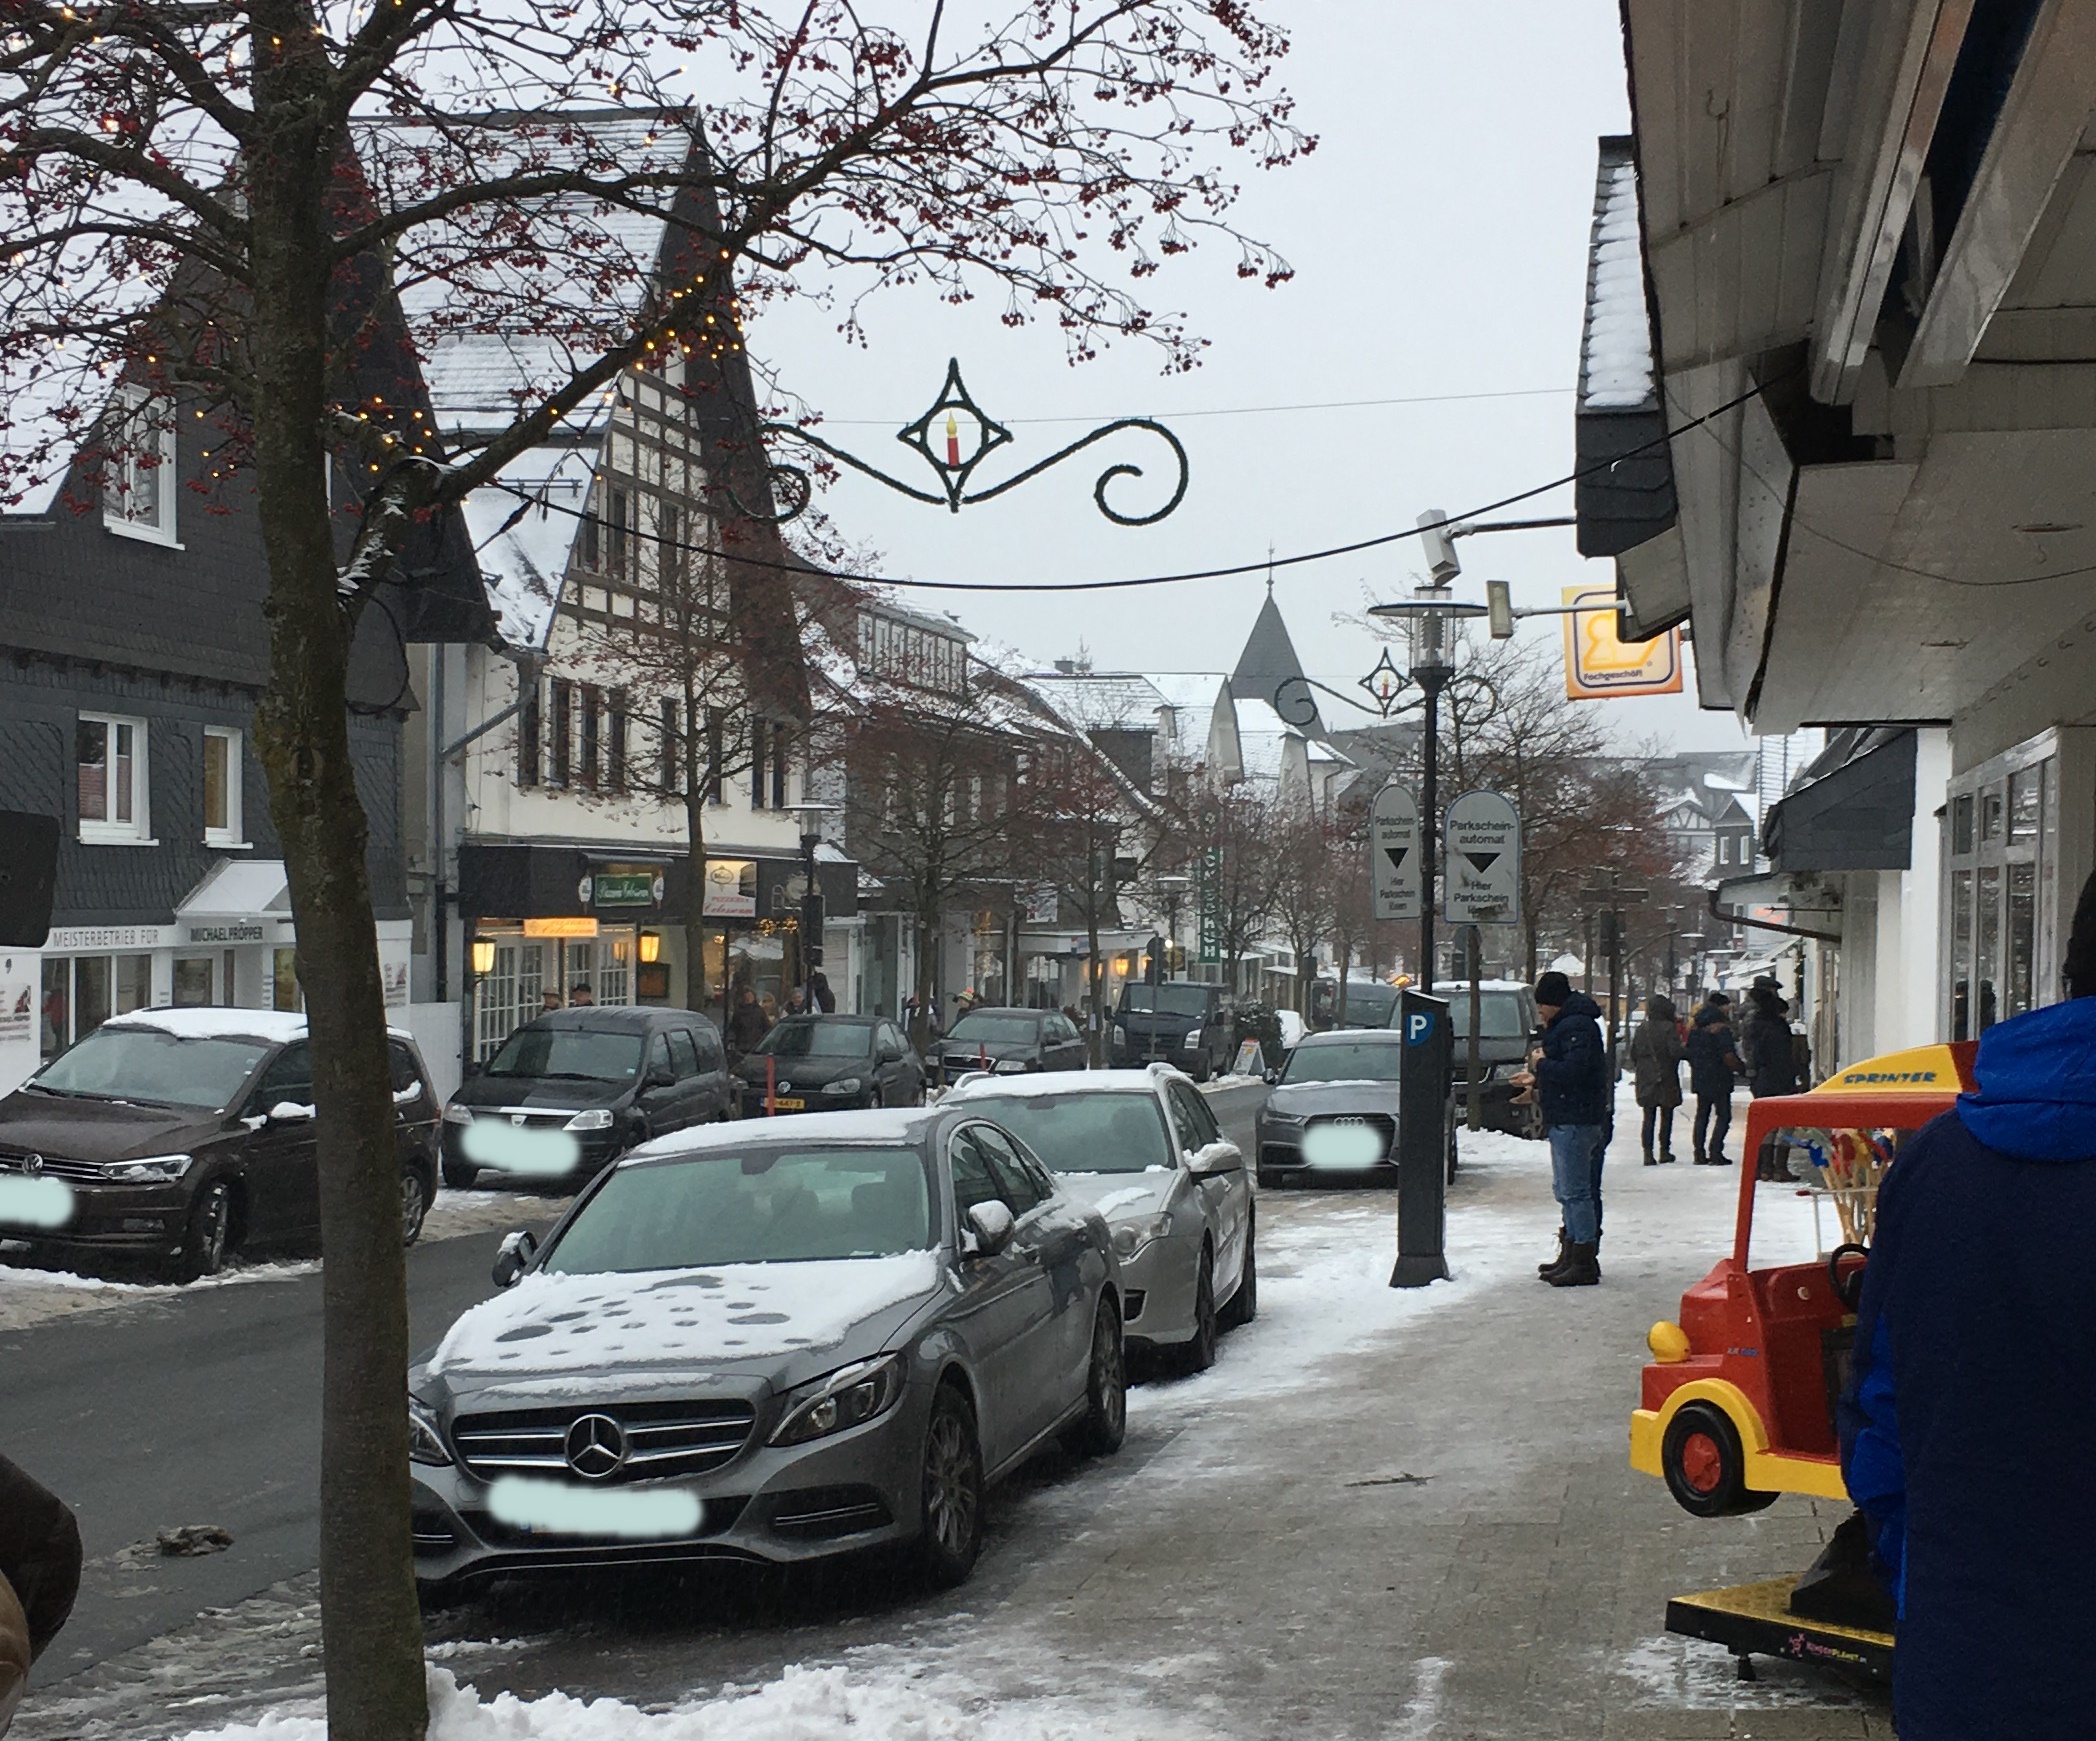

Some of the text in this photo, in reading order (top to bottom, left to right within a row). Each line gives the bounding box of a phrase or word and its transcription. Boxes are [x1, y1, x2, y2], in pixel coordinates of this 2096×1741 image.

[1449, 820, 1515, 831] Parkschein-
[1459, 834, 1505, 844] automat
[1471, 880, 1492, 890] Hier
[1453, 893, 1509, 902] Parkschein
[53, 929, 136, 947] MEISTERBETRIEB
[1410, 1014, 1427, 1040] P
[1844, 1072, 1937, 1085] SPRINTER
